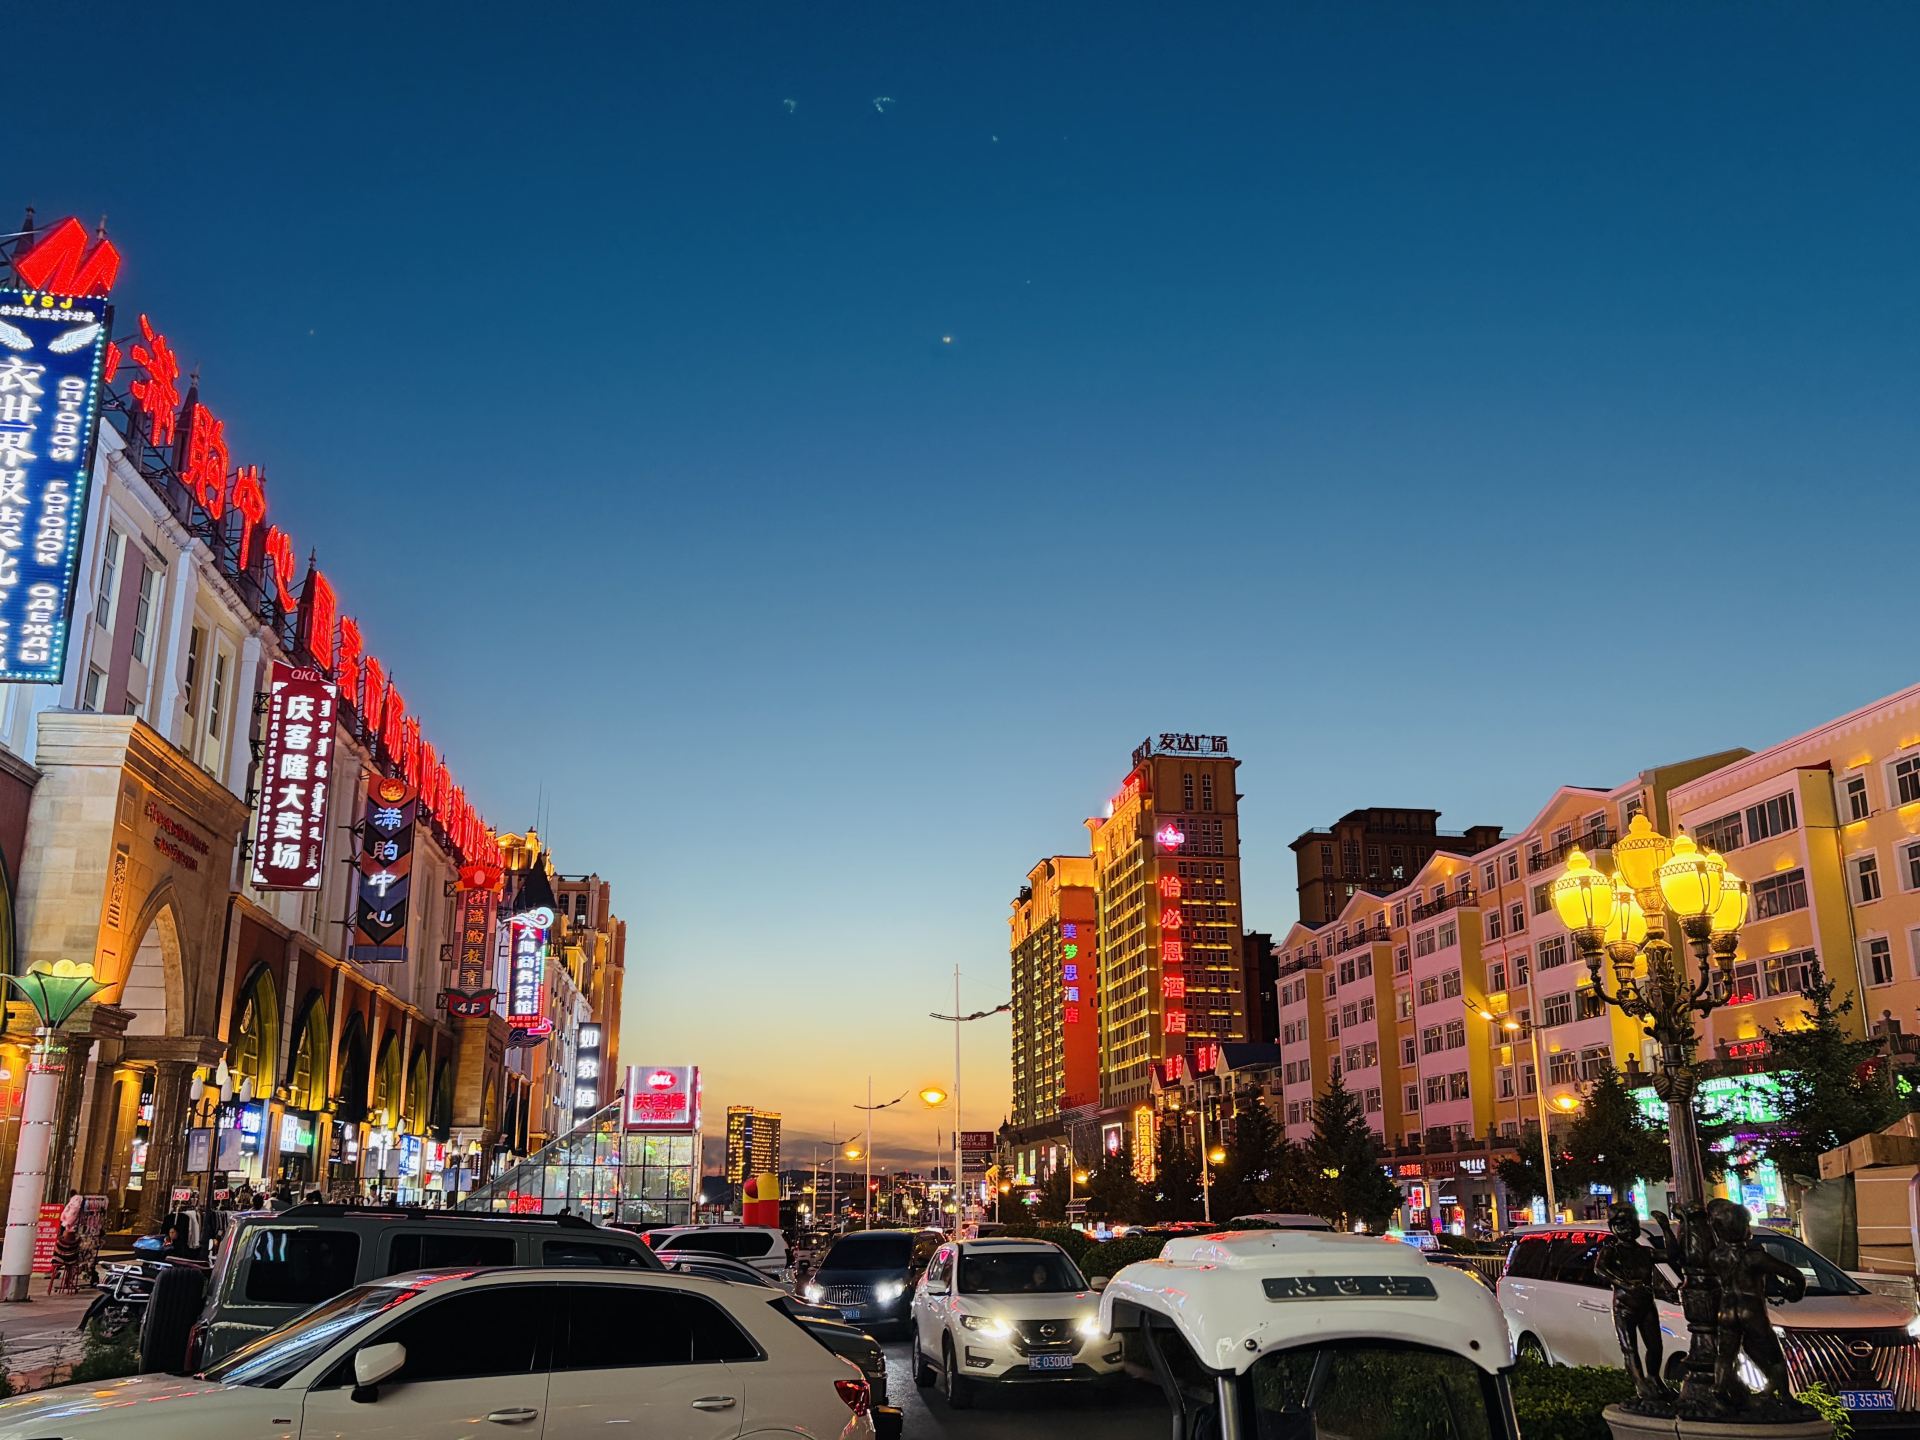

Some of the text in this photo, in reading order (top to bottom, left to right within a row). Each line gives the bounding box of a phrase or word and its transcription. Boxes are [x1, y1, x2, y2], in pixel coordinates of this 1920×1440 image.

[22, 294, 73, 309] YSJ
[36, 481, 69, 565] ГОРОДОК
[20, 585, 57, 662] ОДЕЖДЫ
[291, 669, 318, 682] QKL
[1160, 733, 1228, 753] 发达广场
[269, 695, 315, 870] 庆客隆大卖场
[1062, 923, 1081, 1024] 美梦思酒店
[1159, 876, 1187, 1034] 怡必恩酒店
[632, 1093, 687, 1112] 庆客隆
